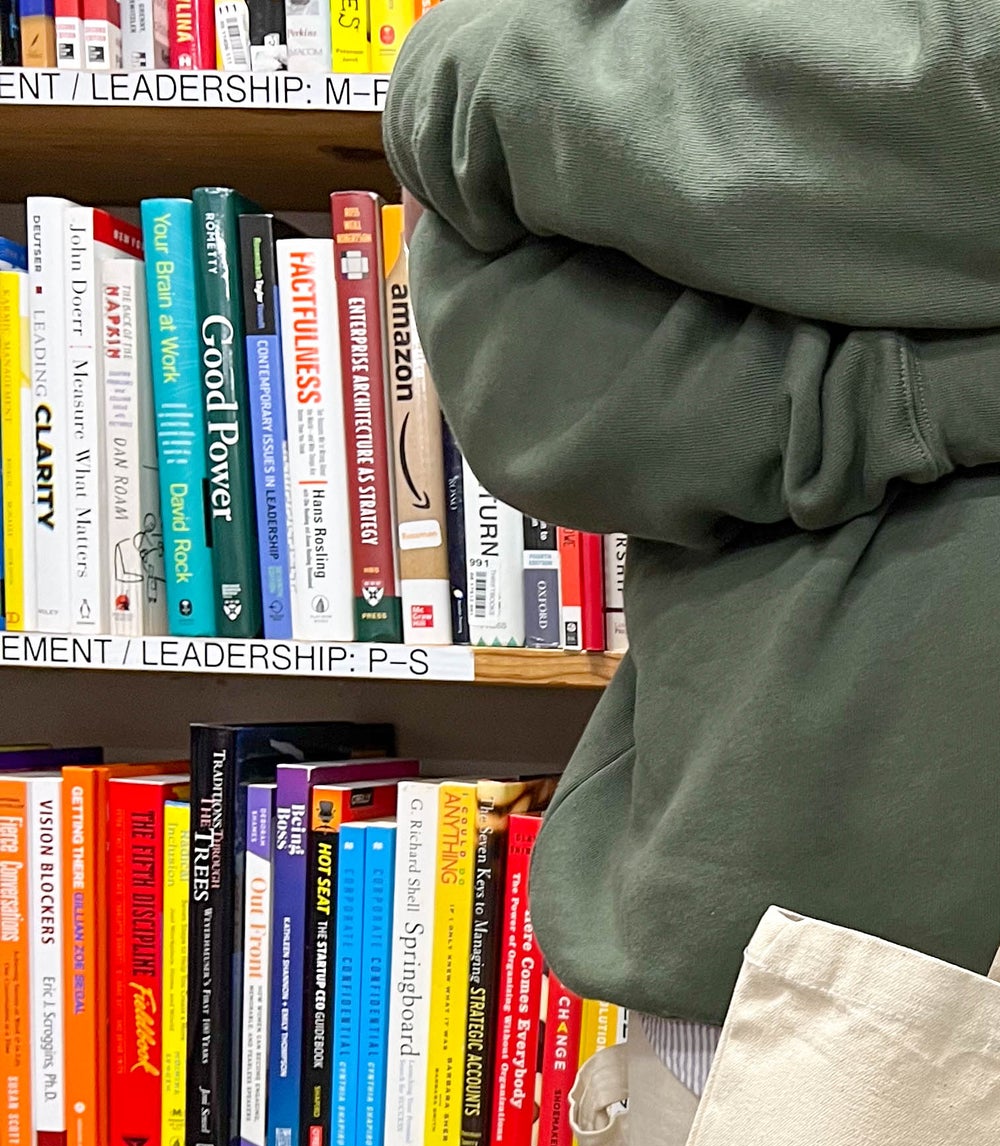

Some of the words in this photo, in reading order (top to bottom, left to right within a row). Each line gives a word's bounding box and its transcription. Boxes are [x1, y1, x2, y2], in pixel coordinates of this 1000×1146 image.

[92, 73, 312, 104] LEADERSHIP:
[33, 215, 43, 272] DEUTSER
[69, 224, 87, 271] John
[153, 213, 172, 254] Your
[71, 280, 88, 336] Doerr
[154, 261, 174, 308] Brain
[105, 286, 121, 359] NAPKIN
[158, 316, 173, 332] at
[289, 251, 322, 404] FACTFULNESS
[391, 284, 414, 401] amazon
[33, 310, 48, 397] LEADING
[160, 336, 181, 384] Work
[202, 315, 239, 412] Good
[72, 360, 89, 440] Measure
[35, 404, 55, 531] CLARITY
[75, 449, 91, 497] What
[208, 420, 239, 522] Power
[169, 483, 189, 532] David
[313, 489, 325, 523] Hans
[75, 508, 92, 578] Matters
[174, 539, 192, 584] Rock
[315, 527, 329, 578] Rosling
[470, 558, 489, 567] 991
[2, 636, 112, 664] EMENT
[142, 640, 355, 673] LEADERSHIP:
[39, 800, 54, 855] VISION
[71, 786, 84, 844] GETTING
[412, 798, 423, 815] G.
[317, 842, 332, 875] HOT
[408, 820, 422, 874] Richard
[441, 792, 461, 885] ANYTHING
[72, 847, 85, 889] THERE
[193, 831, 215, 902] TREES
[40, 863, 55, 945] BLOCKERS
[317, 877, 331, 915] SEAT
[407, 878, 421, 913] Shell
[317, 921, 328, 937] THE
[315, 938, 327, 982] STARTUP
[315, 986, 326, 1010] CEO
[398, 922, 424, 1057] Springboard
[130, 982, 160, 1077] Fieldbook
[313, 1012, 326, 1069] GUIDEBOOK
[554, 996, 570, 1070] CHANGE
